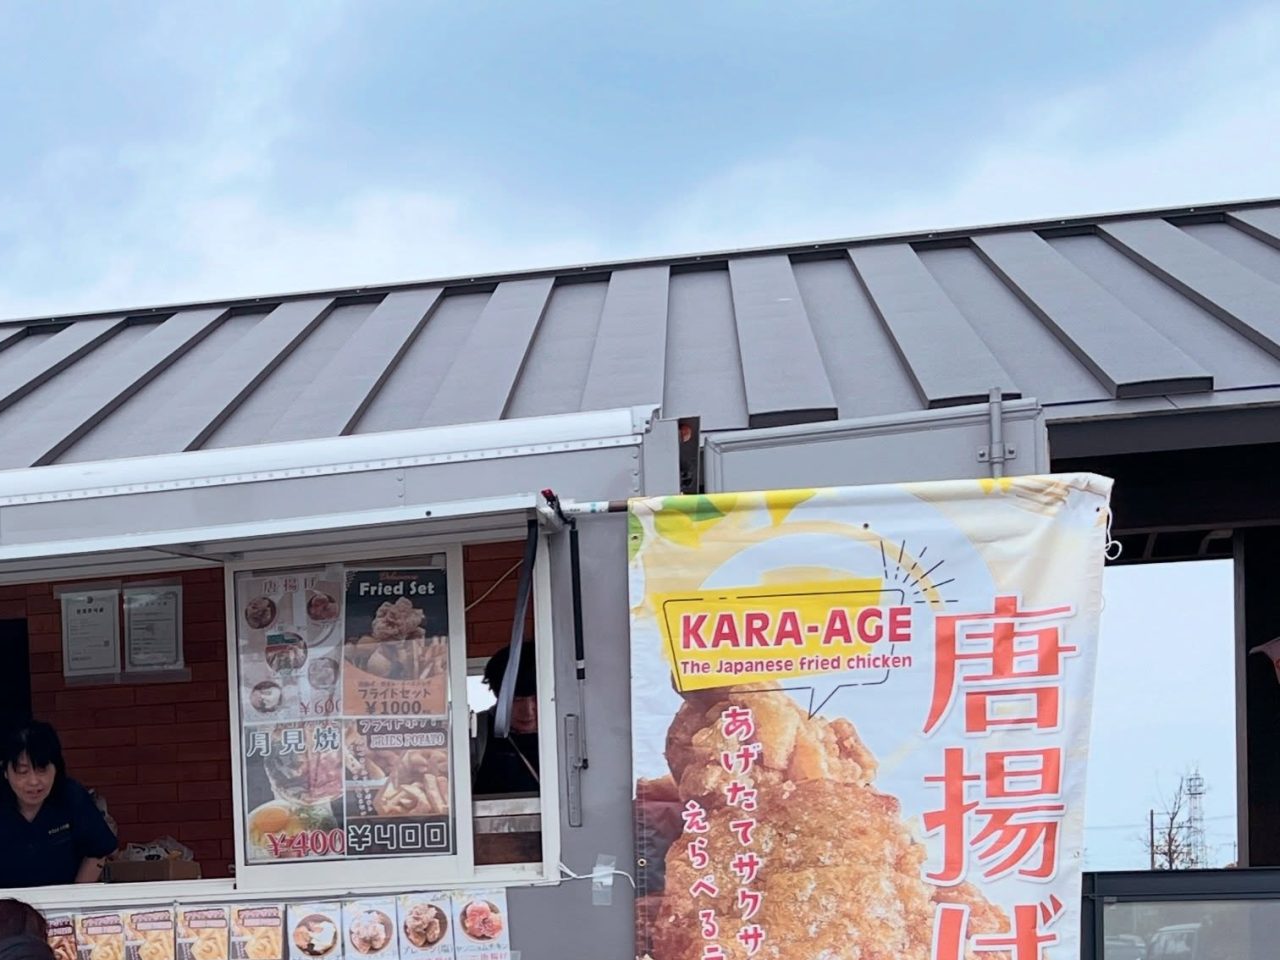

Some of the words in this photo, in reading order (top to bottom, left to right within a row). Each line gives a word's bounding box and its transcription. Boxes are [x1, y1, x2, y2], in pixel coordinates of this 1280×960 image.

[359, 581, 404, 596] Fried
[409, 581, 435, 594] Set
[682, 605, 912, 650] KARA-AGE
[681, 660, 710, 674] The
[716, 657, 794, 675] Japanese
[800, 655, 842, 671] fried
[847, 653, 913, 669] chicken
[358, 688, 431, 700] フライドセット
[365, 700, 422, 715] ¥1000
[247, 726, 341, 758] 月見焼
[404, 732, 445, 747] POTATO
[267, 828, 345, 857] ¥400
[348, 821, 447, 851] ¥400
